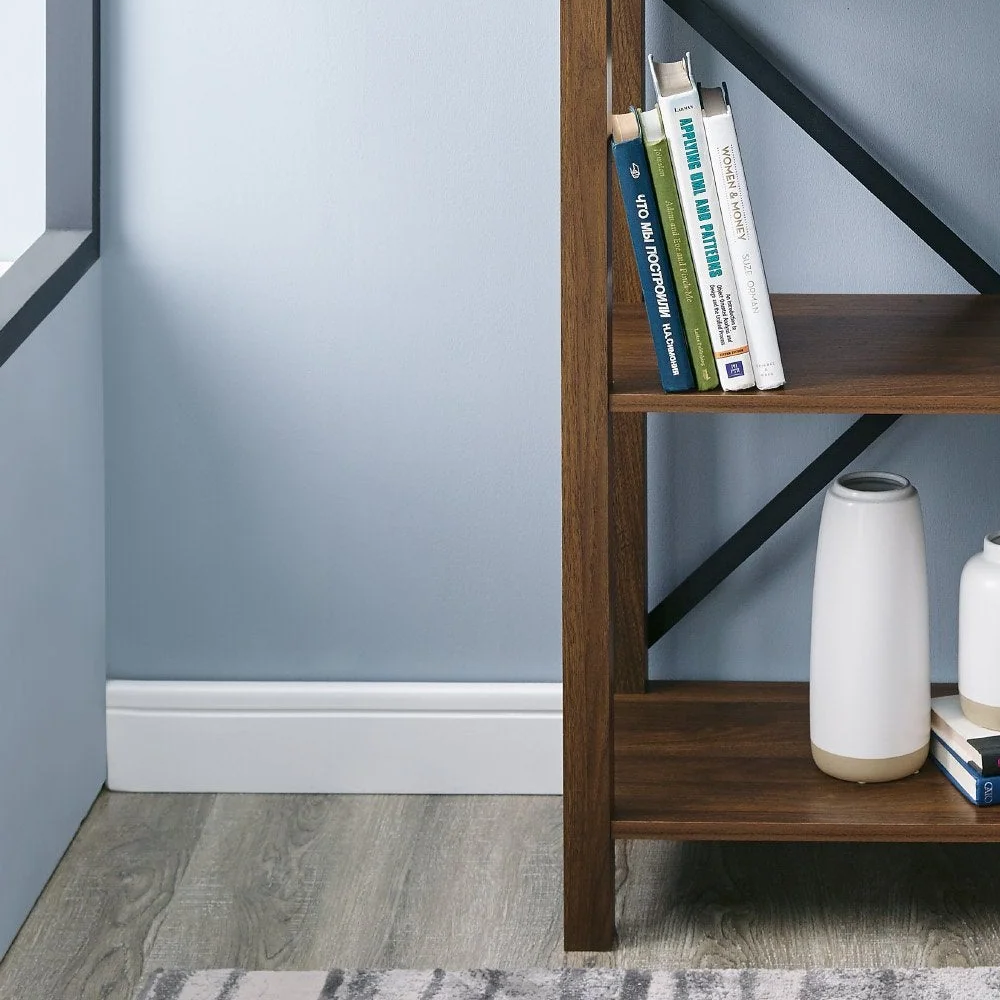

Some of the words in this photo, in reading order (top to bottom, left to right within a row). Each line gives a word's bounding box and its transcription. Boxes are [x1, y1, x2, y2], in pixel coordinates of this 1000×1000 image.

[679, 117, 701, 170] APPLYING
[722, 145, 736, 189] WOMEN
[690, 172, 706, 196] UML
[730, 191, 738, 199] &
[635, 193, 650, 220] ЧТО
[695, 199, 712, 221] AND
[640, 222, 655, 243] МЫ
[670, 223, 680, 236] and
[732, 201, 746, 240] MONEY
[673, 238, 681, 251] Eve
[700, 223, 723, 278] PATTERNS
[677, 252, 687, 266] and
[645, 246, 672, 318] ПОСТРОИЛИ
